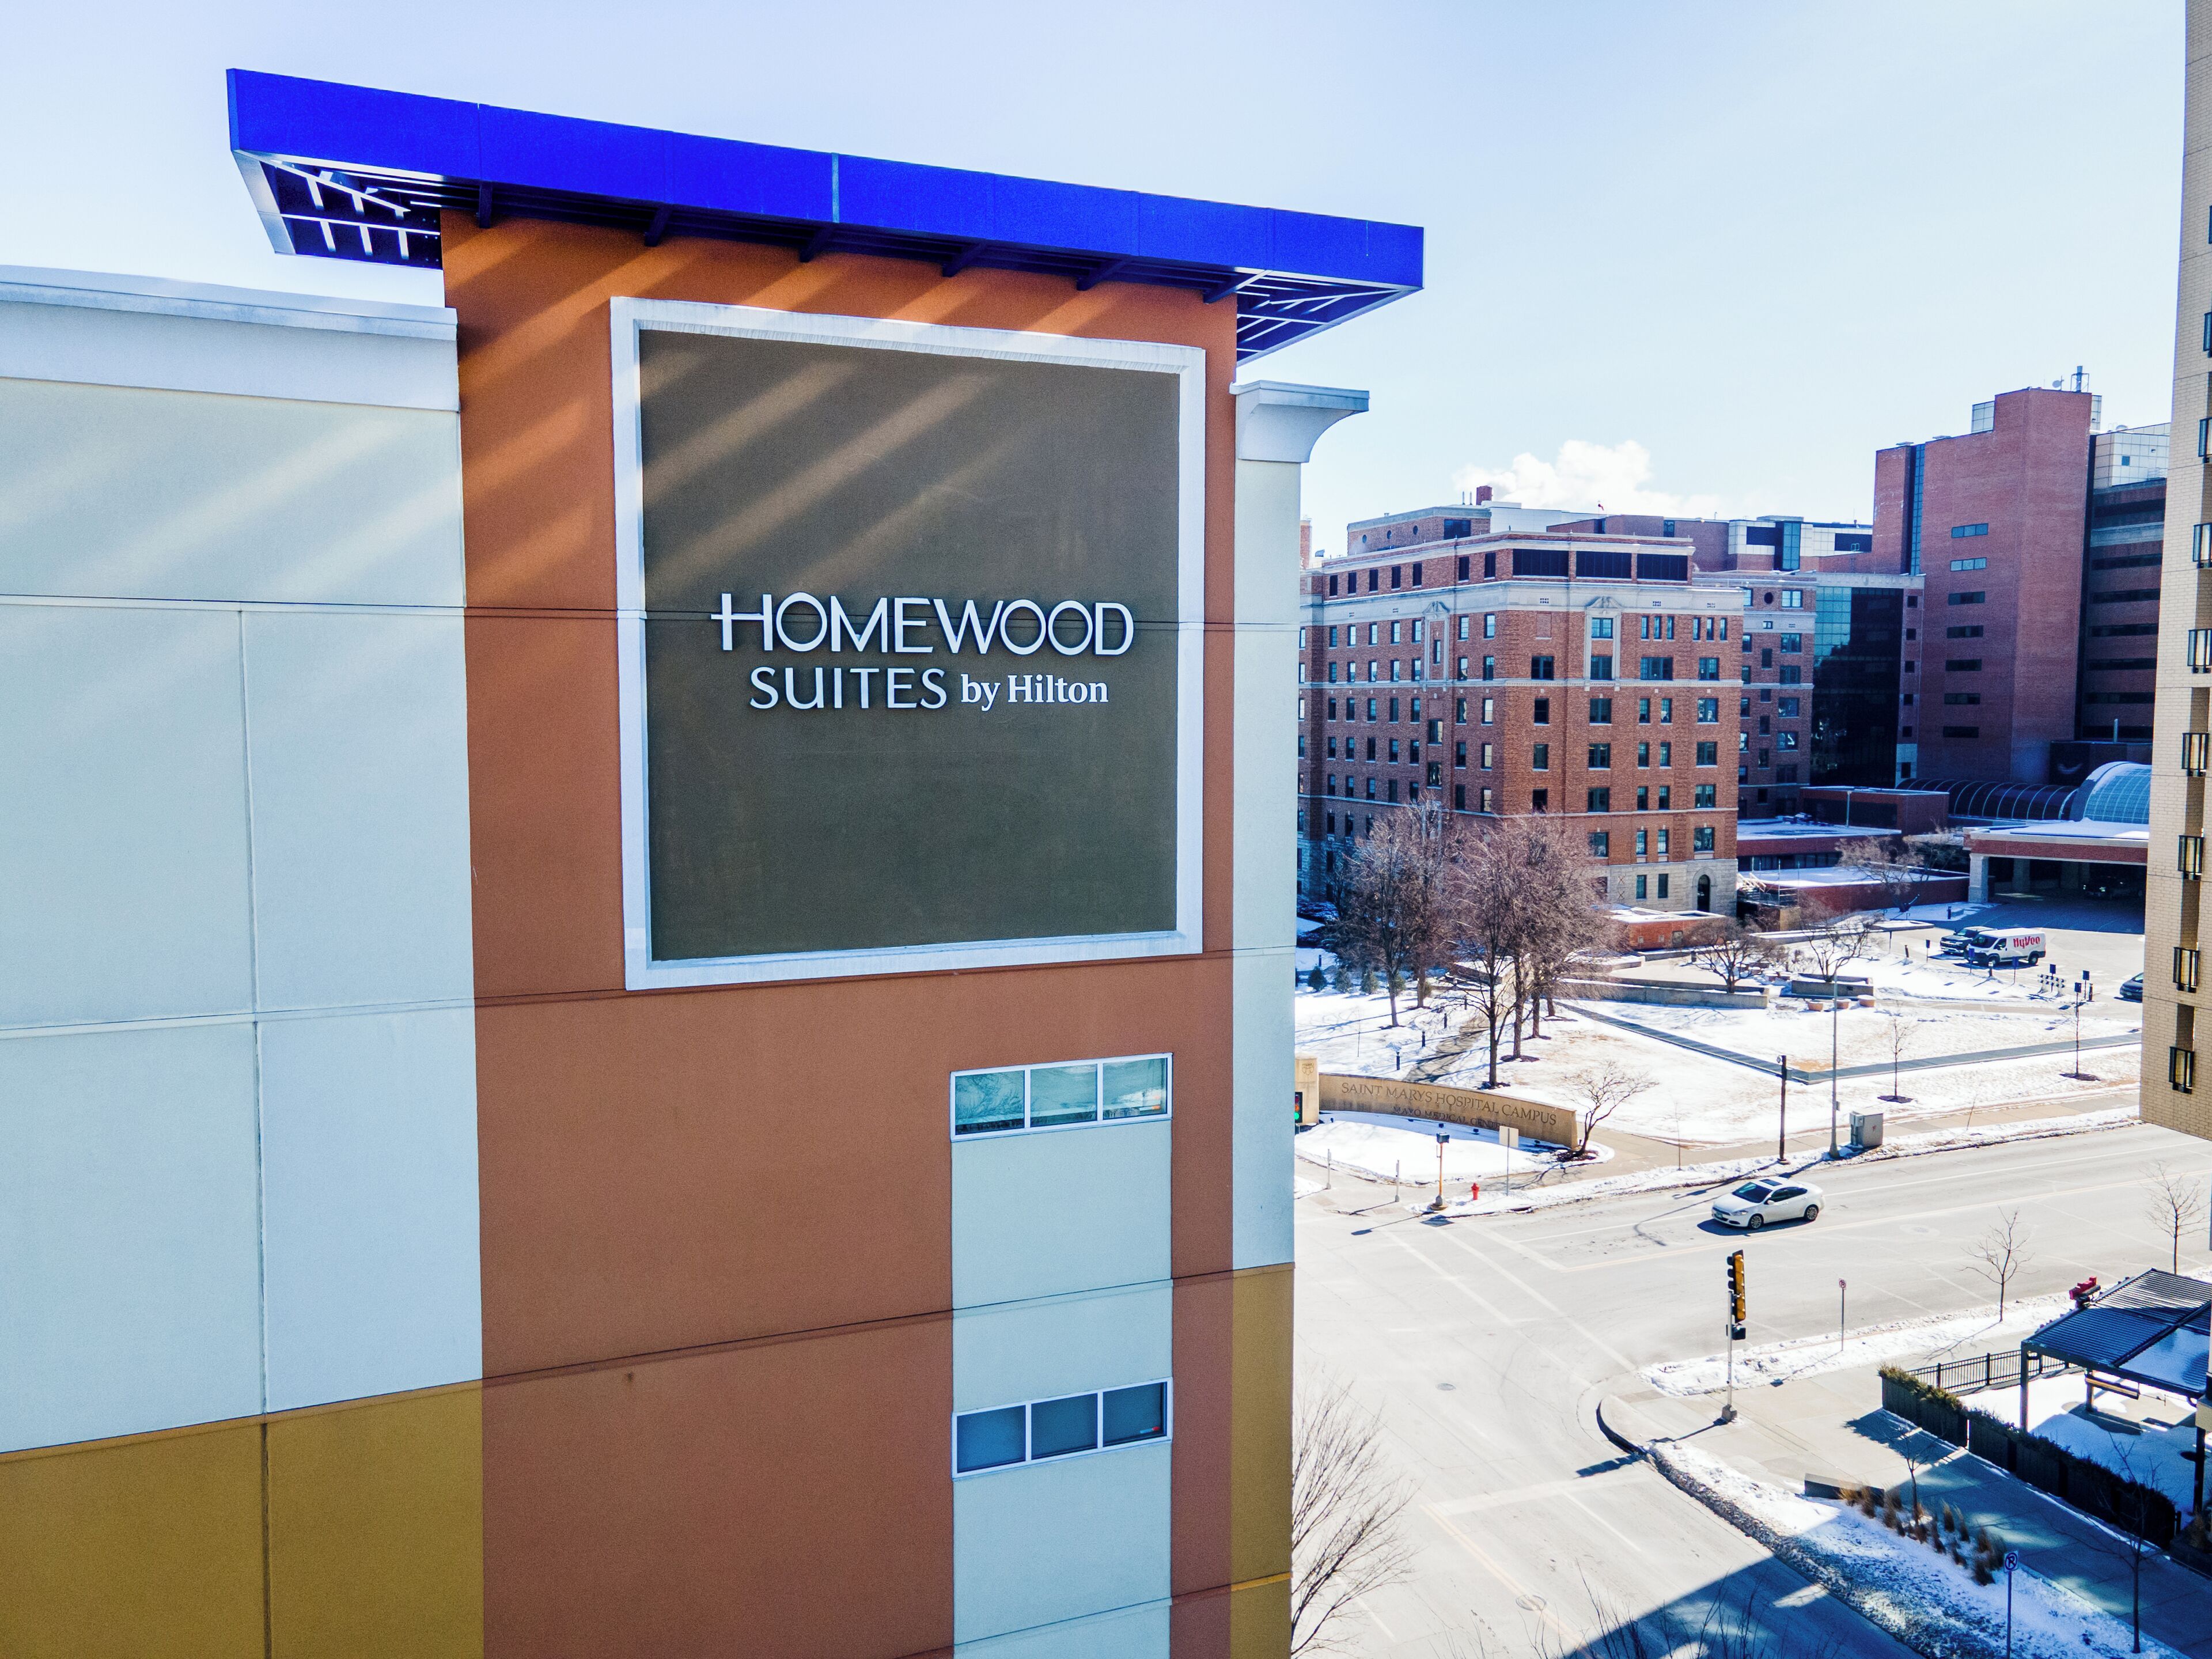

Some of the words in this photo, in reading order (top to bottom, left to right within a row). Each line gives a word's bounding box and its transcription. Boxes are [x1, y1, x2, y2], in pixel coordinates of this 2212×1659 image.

[710, 592, 1134, 656] HOMEWOOD
[749, 666, 947, 710] SUITES
[960, 673, 1001, 711] by
[1007, 675, 1108, 703] Hilton
[1341, 1082, 1382, 1096] SAINT
[1386, 1086, 1432, 1103] MARYS
[1436, 1093, 1499, 1113] HOSPITAL
[1501, 1104, 1556, 1126] CAMPUS
[1393, 1105, 1422, 1117] MAYO
[1425, 1111, 1466, 1124] MEDICAL
